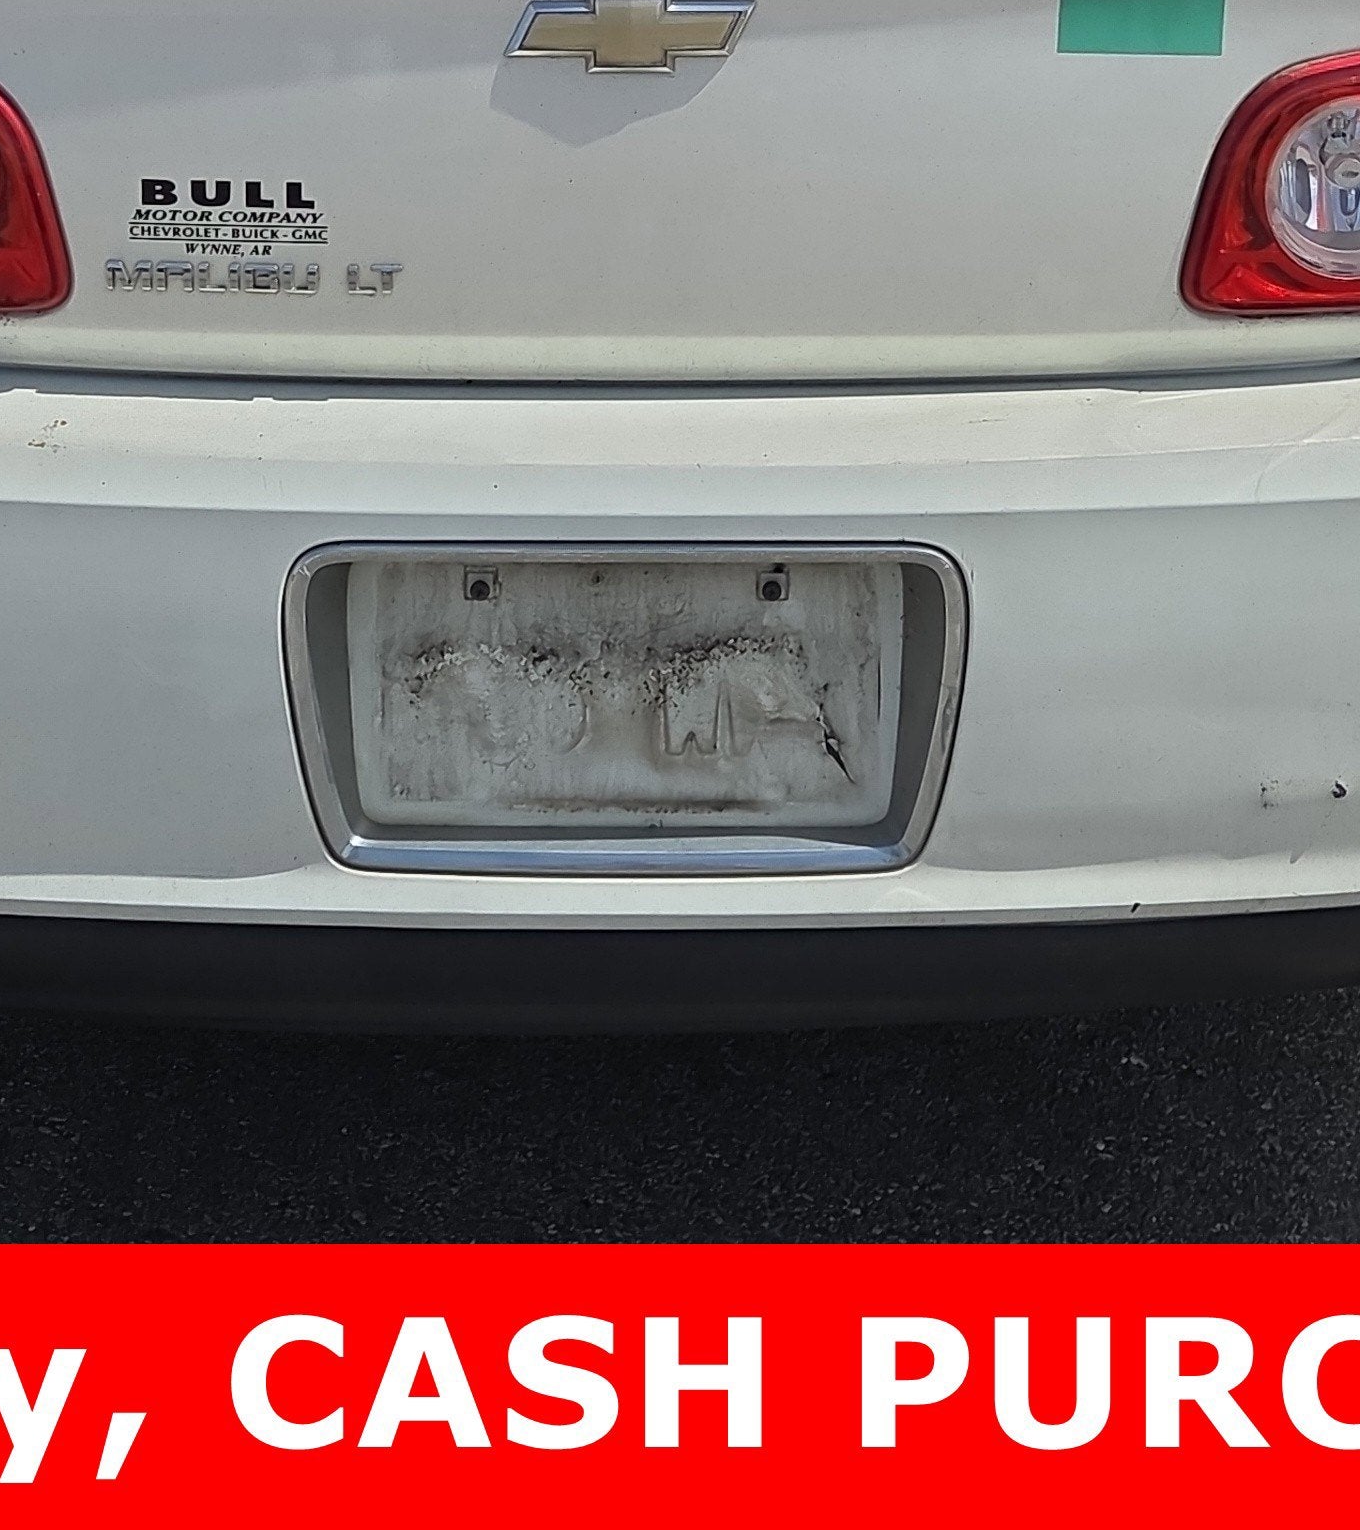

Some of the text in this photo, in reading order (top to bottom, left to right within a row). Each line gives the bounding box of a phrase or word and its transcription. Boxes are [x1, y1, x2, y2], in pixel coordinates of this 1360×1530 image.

[141, 178, 316, 209] BULL
[131, 209, 324, 225] MOTOR COMPANY
[185, 243, 273, 257] WYNNE, AR
[105, 259, 404, 296] MALIBU LT
